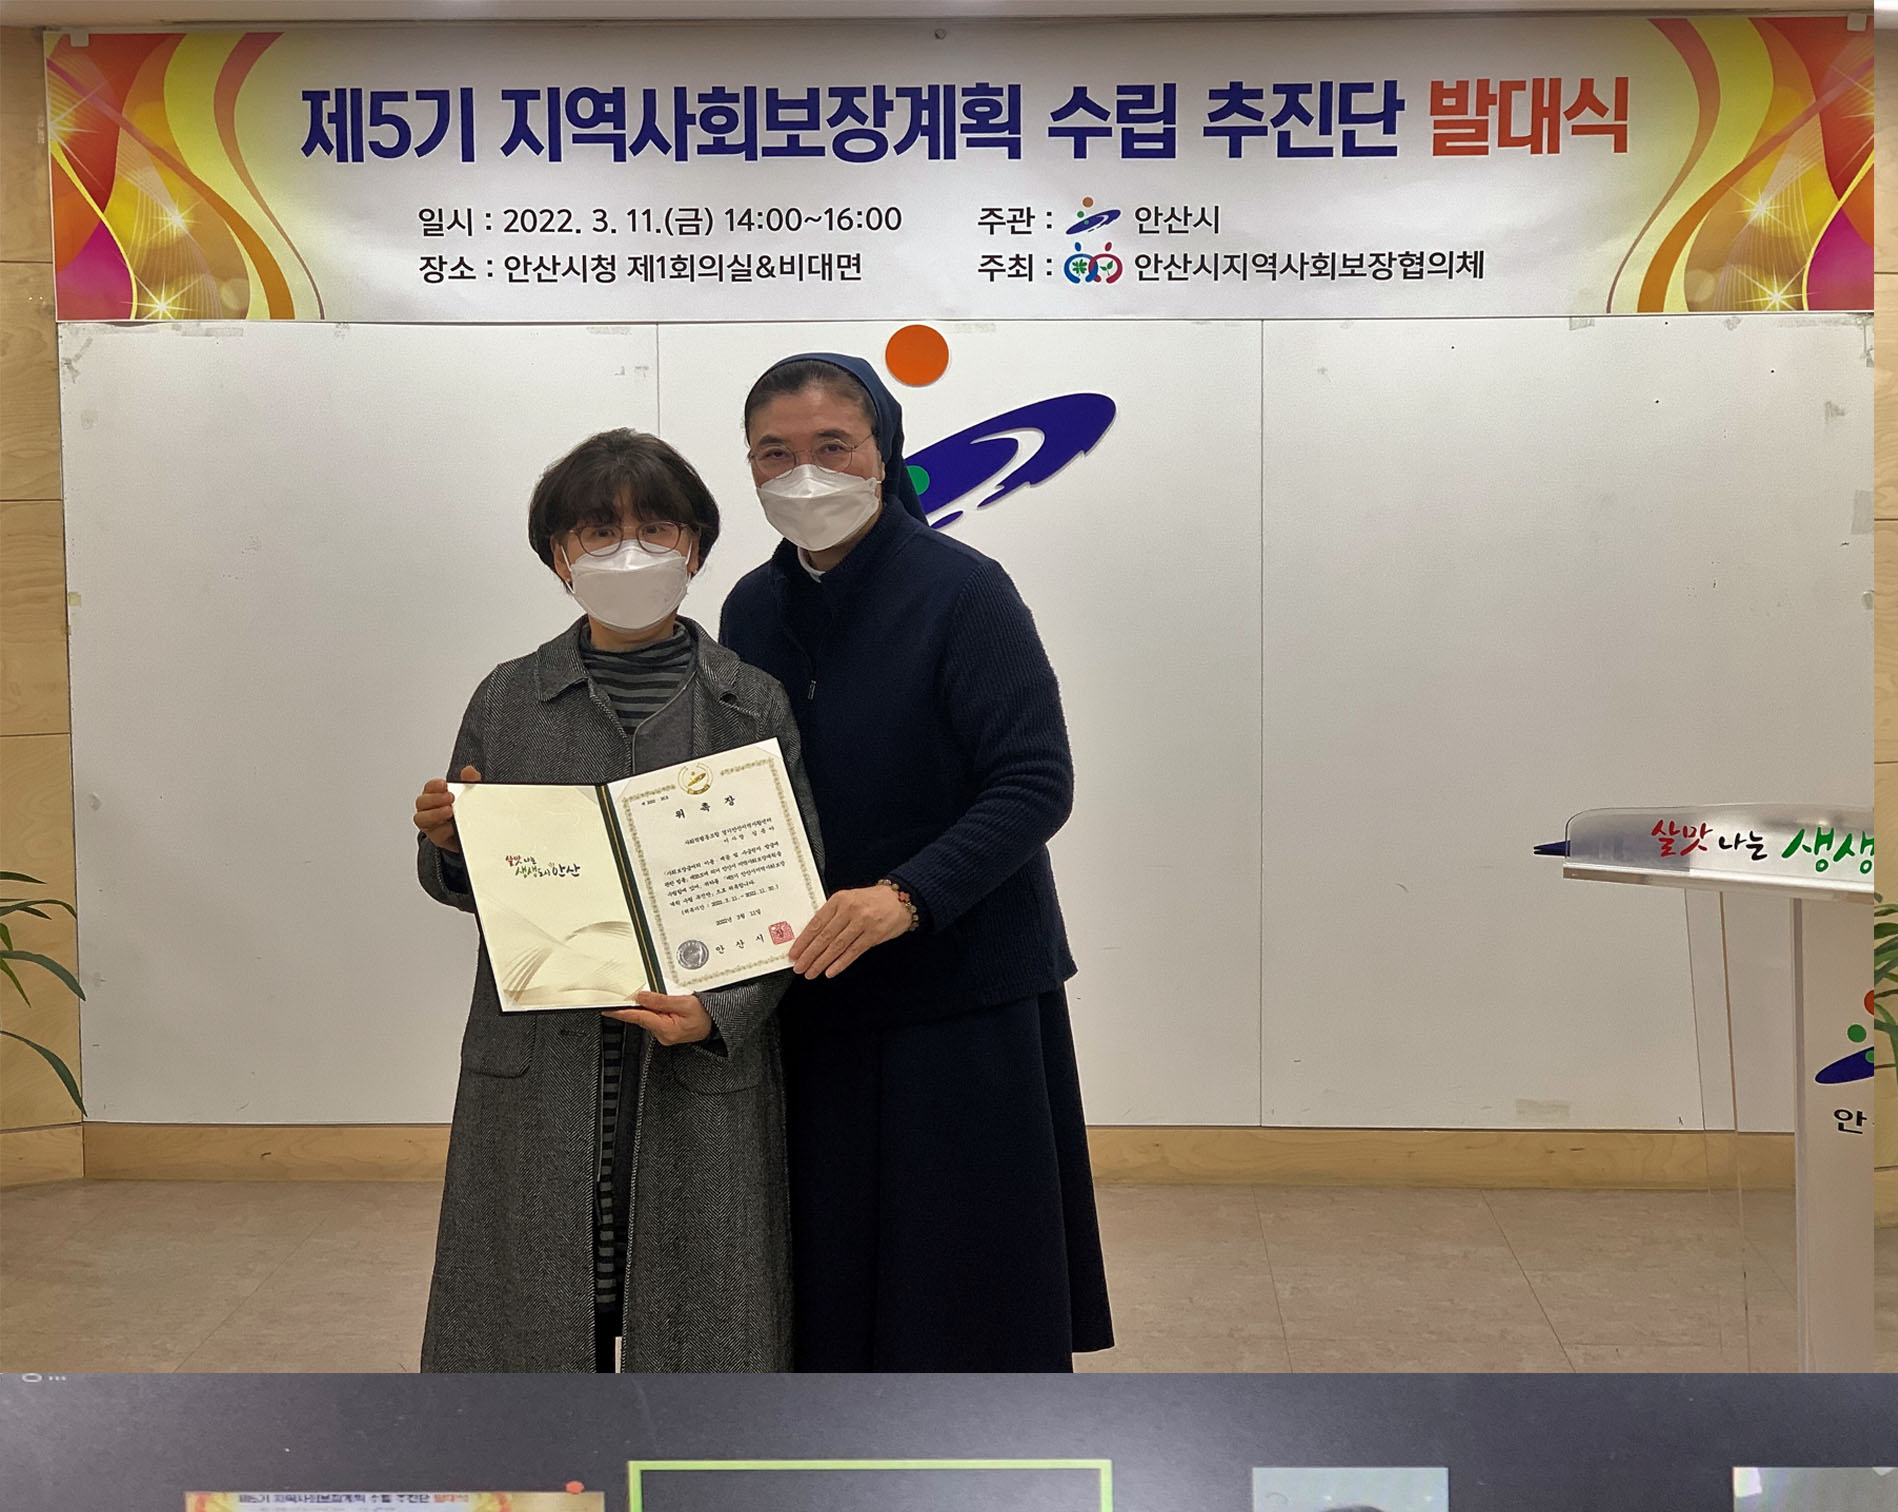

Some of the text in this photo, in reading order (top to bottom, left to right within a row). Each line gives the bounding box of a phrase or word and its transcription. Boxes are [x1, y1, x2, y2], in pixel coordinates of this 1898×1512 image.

[301, 75, 1628, 164] 제5기 지역사회보장계획 수립 추진단 발대식
[417, 207, 475, 237] 일시
[503, 208, 581, 237] 2022.
[591, 208, 618, 237] 3.
[626, 207, 714, 240] 11.(금)
[724, 207, 902, 236] 14:00~16:00
[977, 204, 1035, 236] 주관
[1134, 204, 1220, 235] 안산시
[419, 254, 476, 285] 장소
[504, 253, 618, 285] 안산시청
[627, 252, 863, 285] 제1회의실&비대면
[977, 251, 1035, 283] 주최
[1134, 250, 1485, 283] 안산시지역사회보장협의체
[1651, 819, 1713, 857] 살맛
[1718, 831, 1768, 861] 나는
